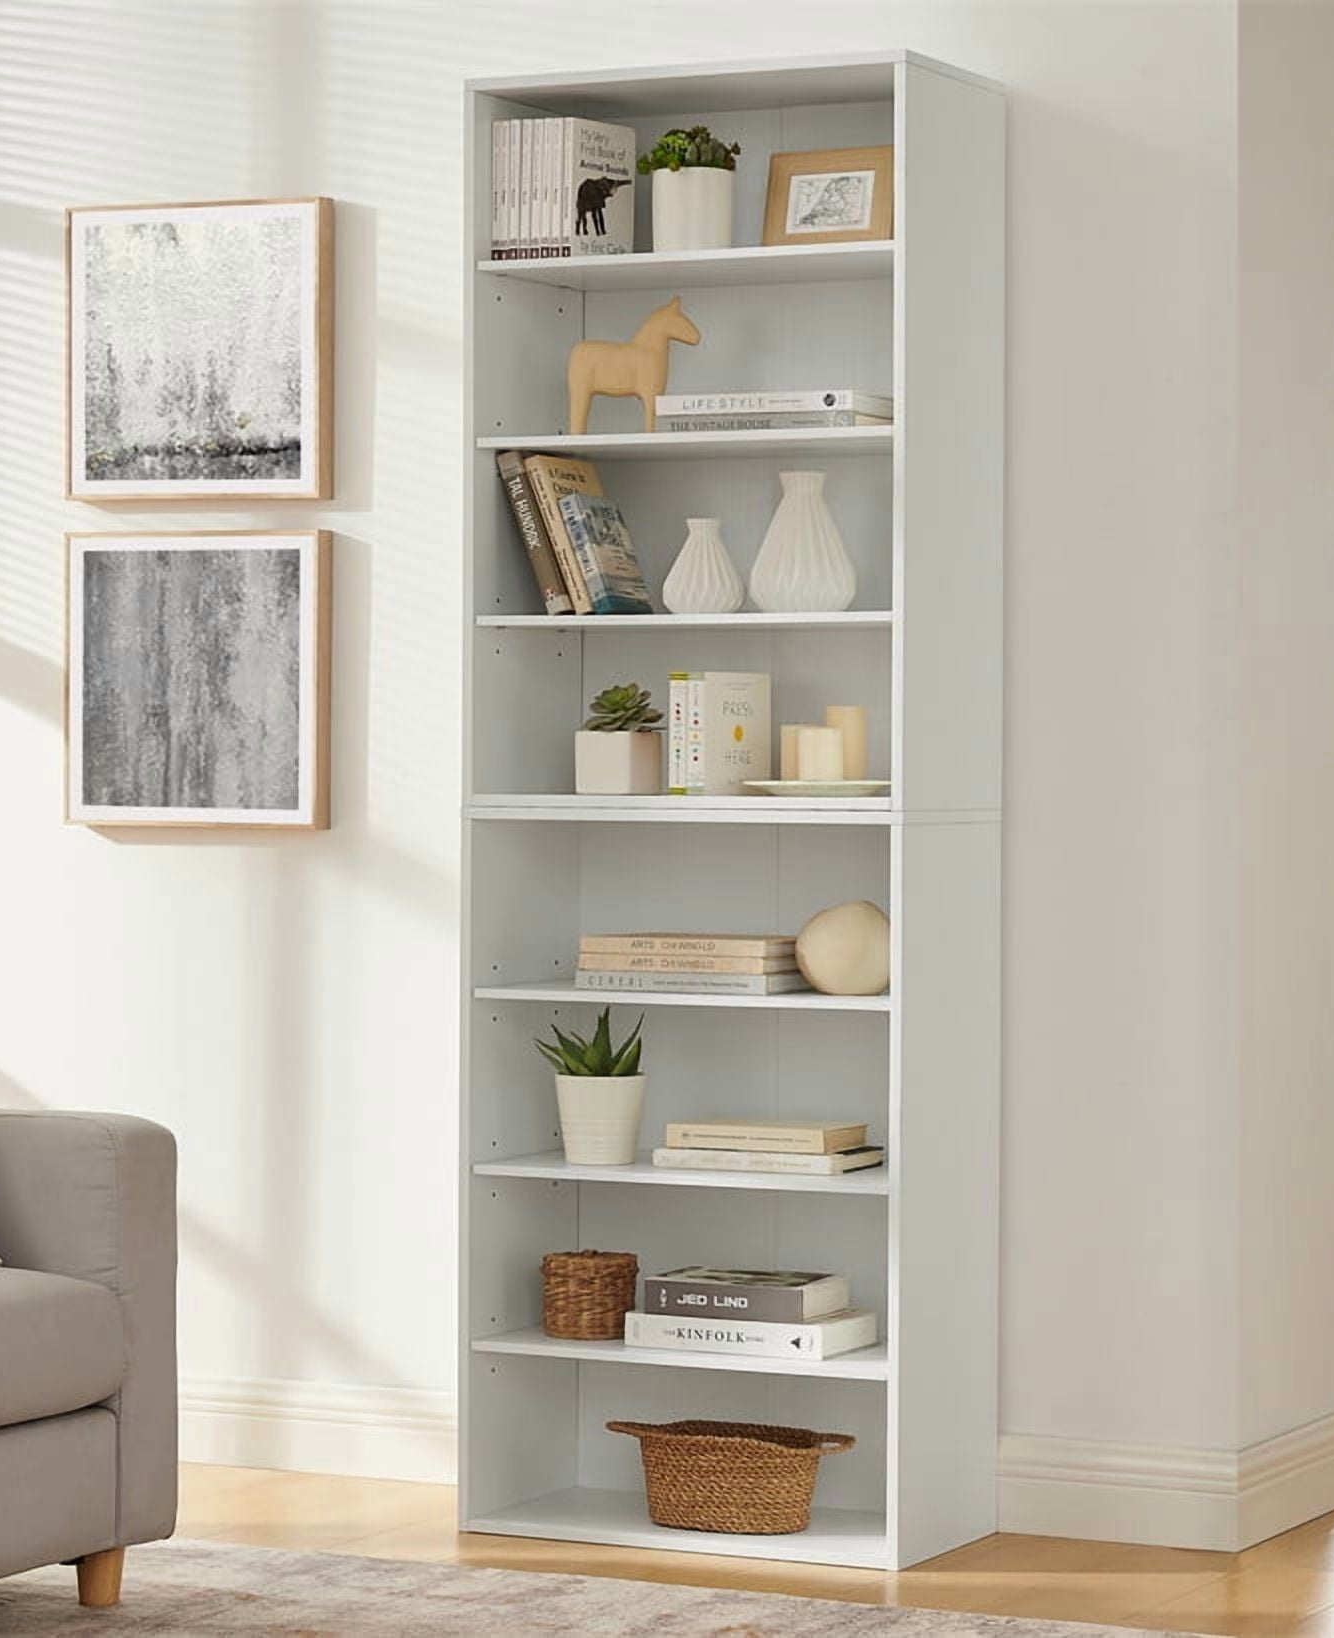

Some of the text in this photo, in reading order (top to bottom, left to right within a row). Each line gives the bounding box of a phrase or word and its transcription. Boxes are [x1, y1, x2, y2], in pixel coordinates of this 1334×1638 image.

[676, 1293, 708, 1306] JED
[713, 1295, 749, 1309] LIND
[676, 1327, 746, 1344] KINFOLK
